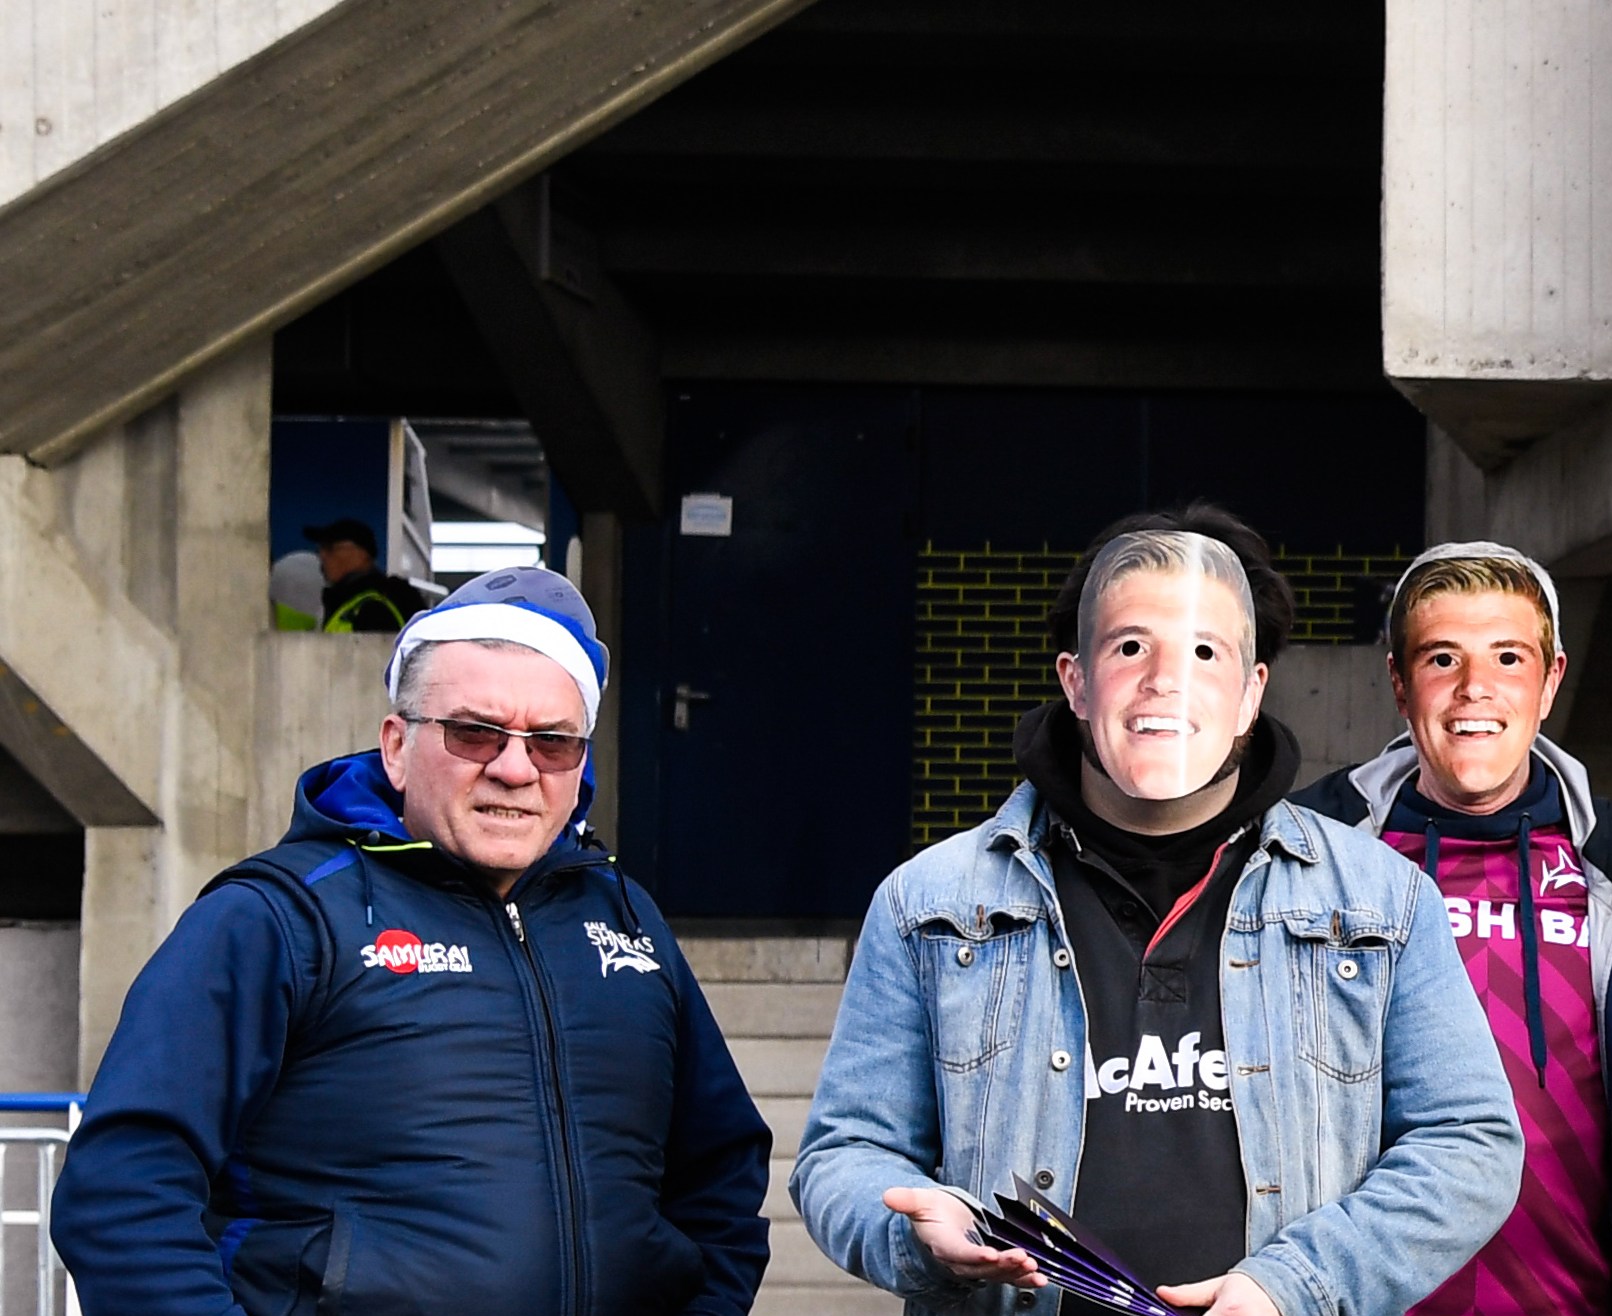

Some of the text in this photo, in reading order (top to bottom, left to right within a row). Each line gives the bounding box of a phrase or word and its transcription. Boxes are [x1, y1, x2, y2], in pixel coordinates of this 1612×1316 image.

[586, 929, 655, 954] SHARKS
[361, 942, 471, 968] SAMURAI
[1085, 1031, 1230, 1099] cAfe
[1125, 1090, 1233, 1113] Proven Sec
